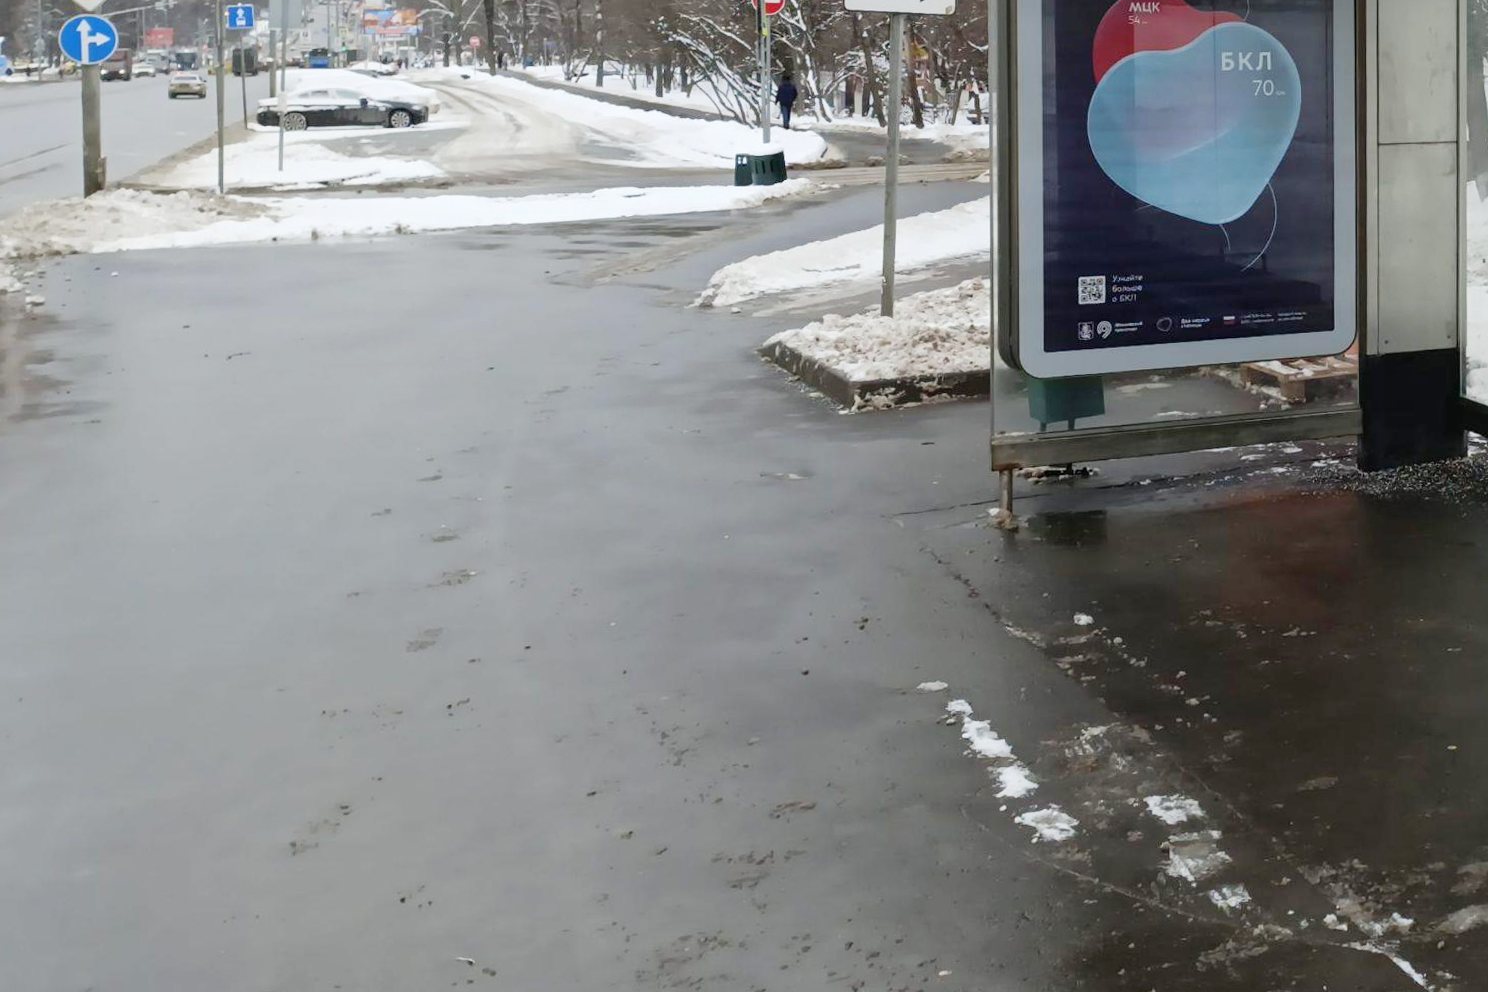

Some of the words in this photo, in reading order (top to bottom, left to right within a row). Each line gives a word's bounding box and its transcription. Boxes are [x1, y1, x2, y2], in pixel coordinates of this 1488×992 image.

[1128, 1, 1160, 14] МЦК
[1128, 15, 1141, 25] 54
[1220, 51, 1272, 72] БКЛ
[1252, 79, 1274, 97] 70
